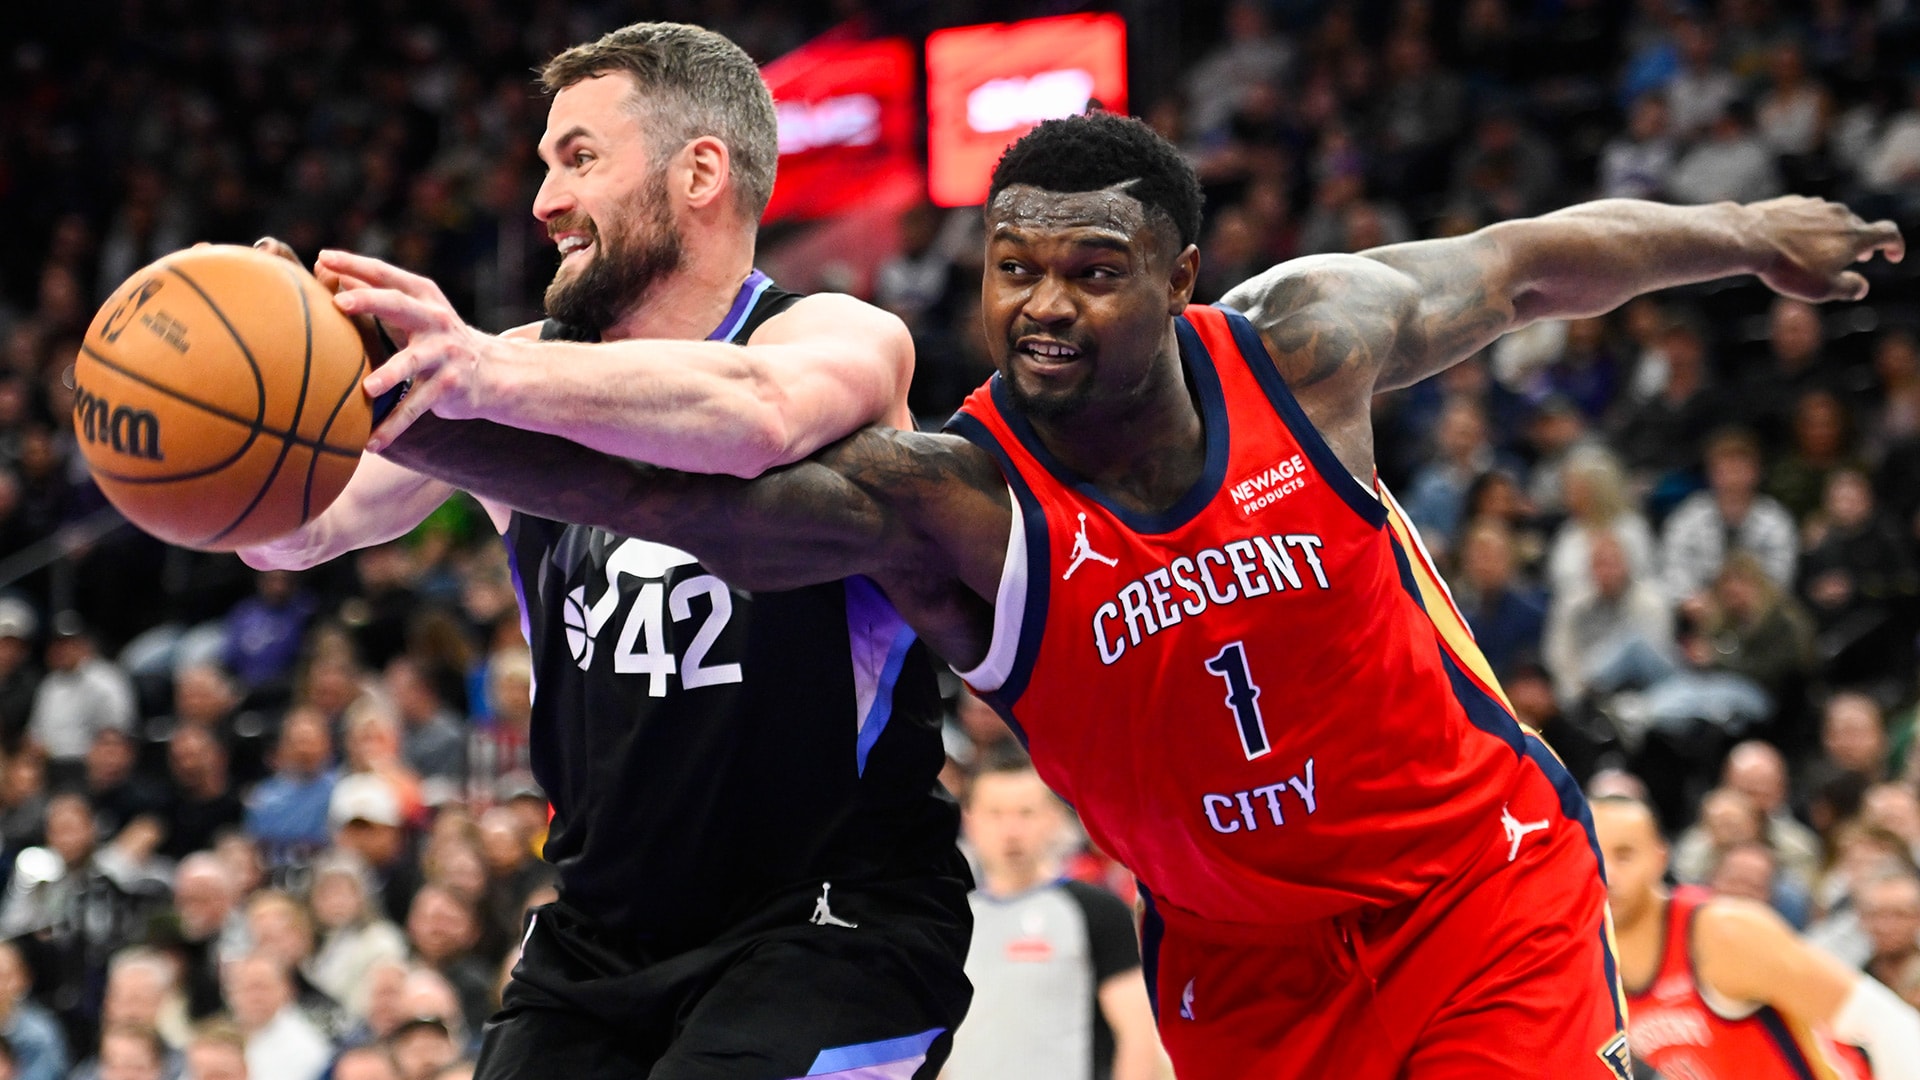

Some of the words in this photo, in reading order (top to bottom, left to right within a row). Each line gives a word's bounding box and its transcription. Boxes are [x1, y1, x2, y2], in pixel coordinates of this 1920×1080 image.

[1230, 454, 1306, 505] NEWAGE
[1243, 477, 1305, 515] PRODUCTS
[614, 574, 743, 698] 42
[1092, 534, 1329, 666] CRESCENT
[1204, 640, 1272, 761] 1
[1203, 757, 1319, 833] CITY
